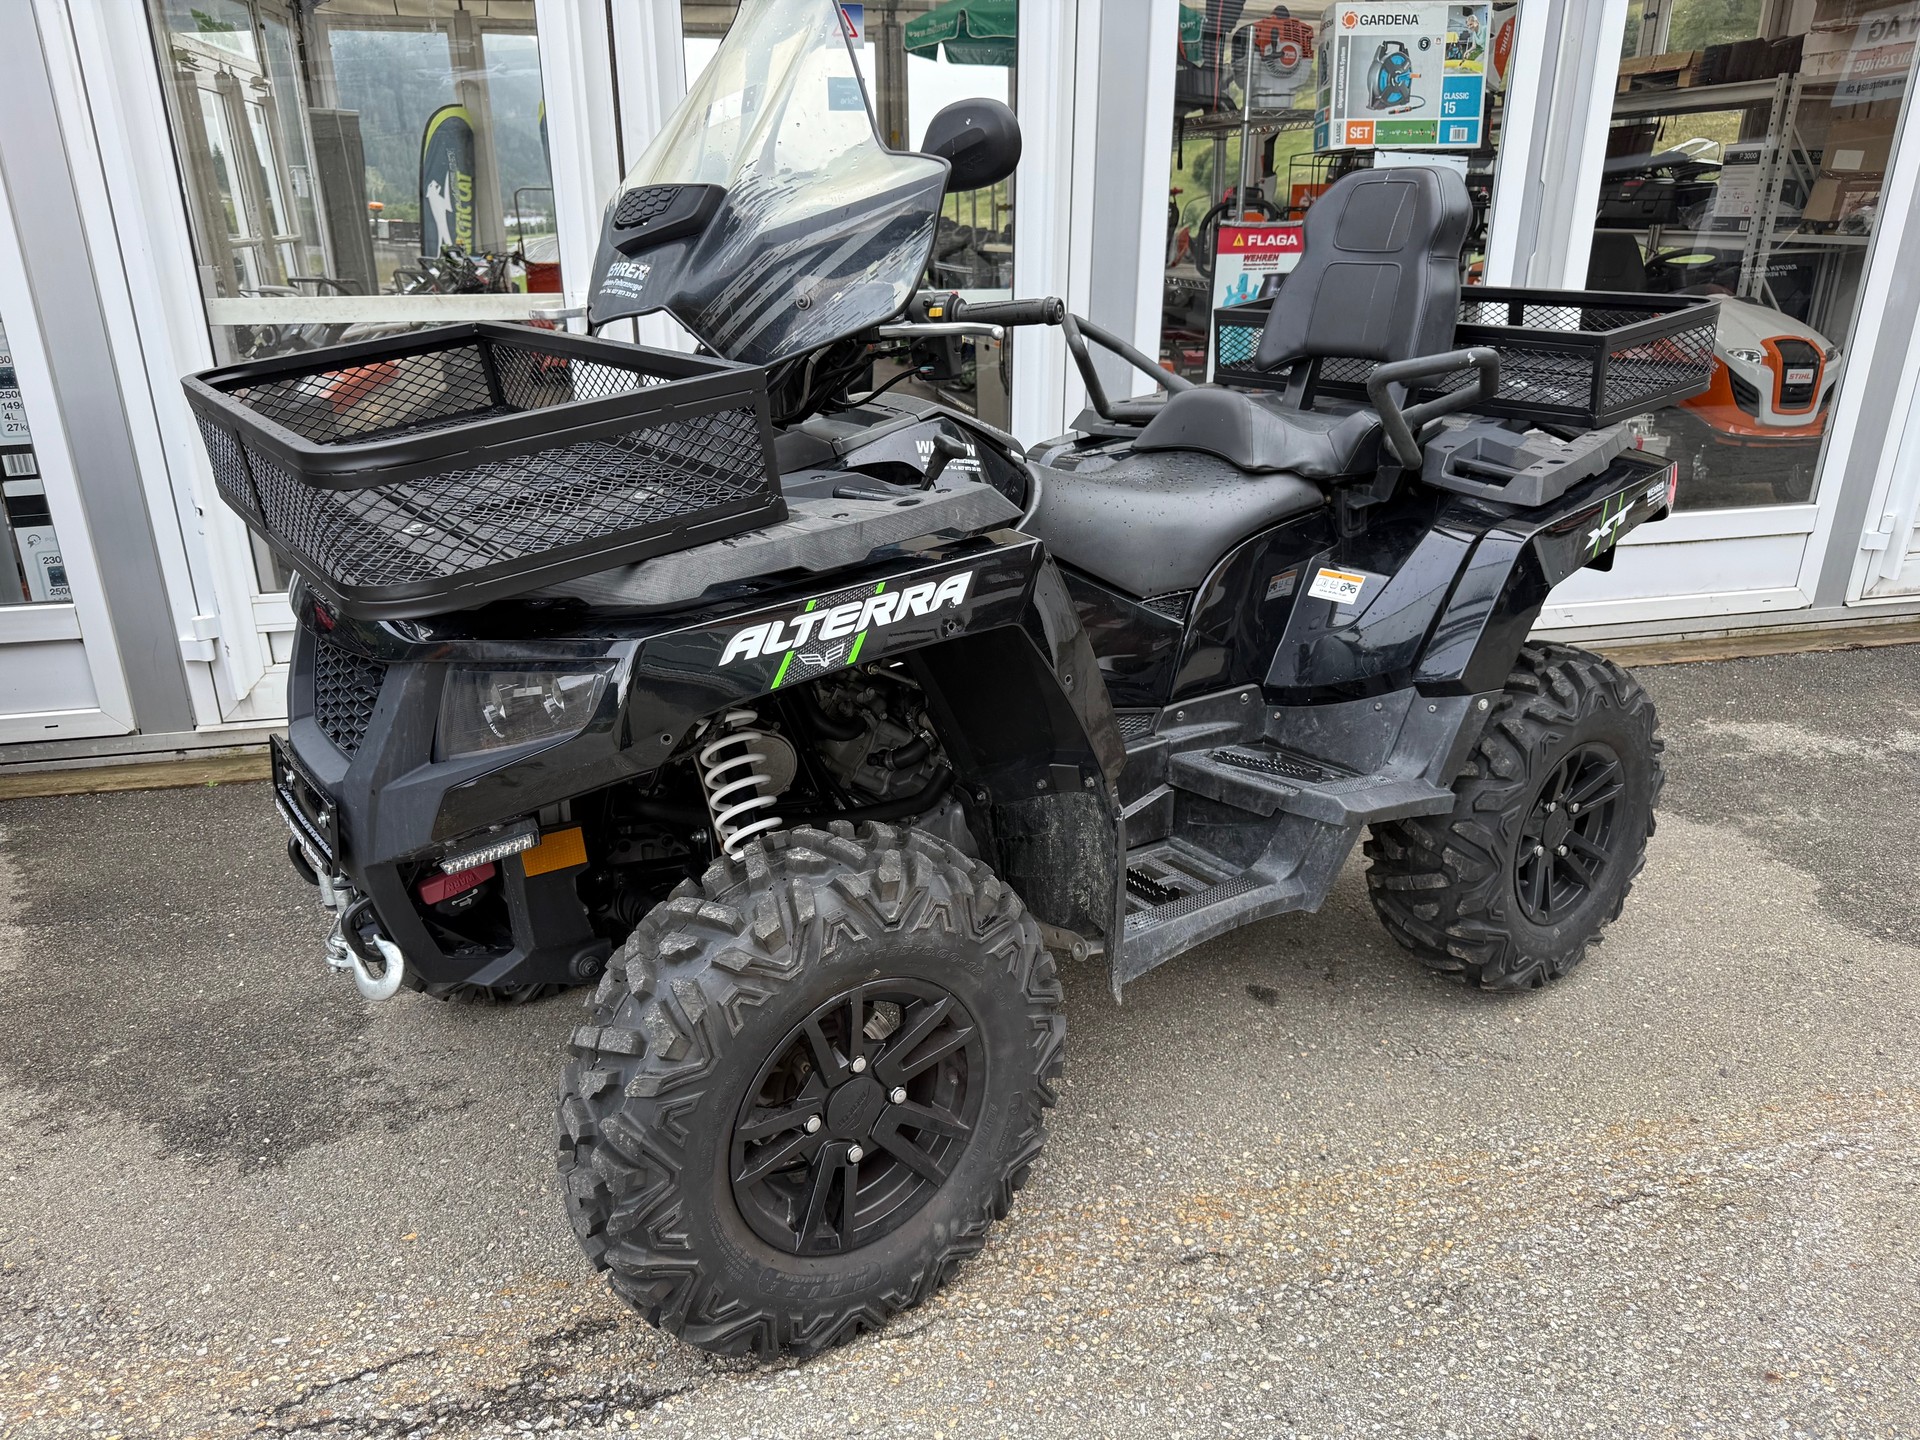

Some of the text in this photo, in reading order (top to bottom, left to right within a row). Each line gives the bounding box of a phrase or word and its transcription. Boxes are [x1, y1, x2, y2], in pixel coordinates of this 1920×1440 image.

[1359, 14, 1419, 25] GARDENA
[1443, 92, 1469, 100] CLASSIC
[1443, 102, 1456, 114] 15
[1349, 127, 1370, 139] SET
[457, 170, 472, 202] CAT
[1247, 234, 1298, 246] FLAGA
[1243, 254, 1279, 262] WEHREN
[1584, 500, 1636, 551] XT
[718, 570, 973, 667] ALTERRA
[447, 873, 475, 891] WARN
